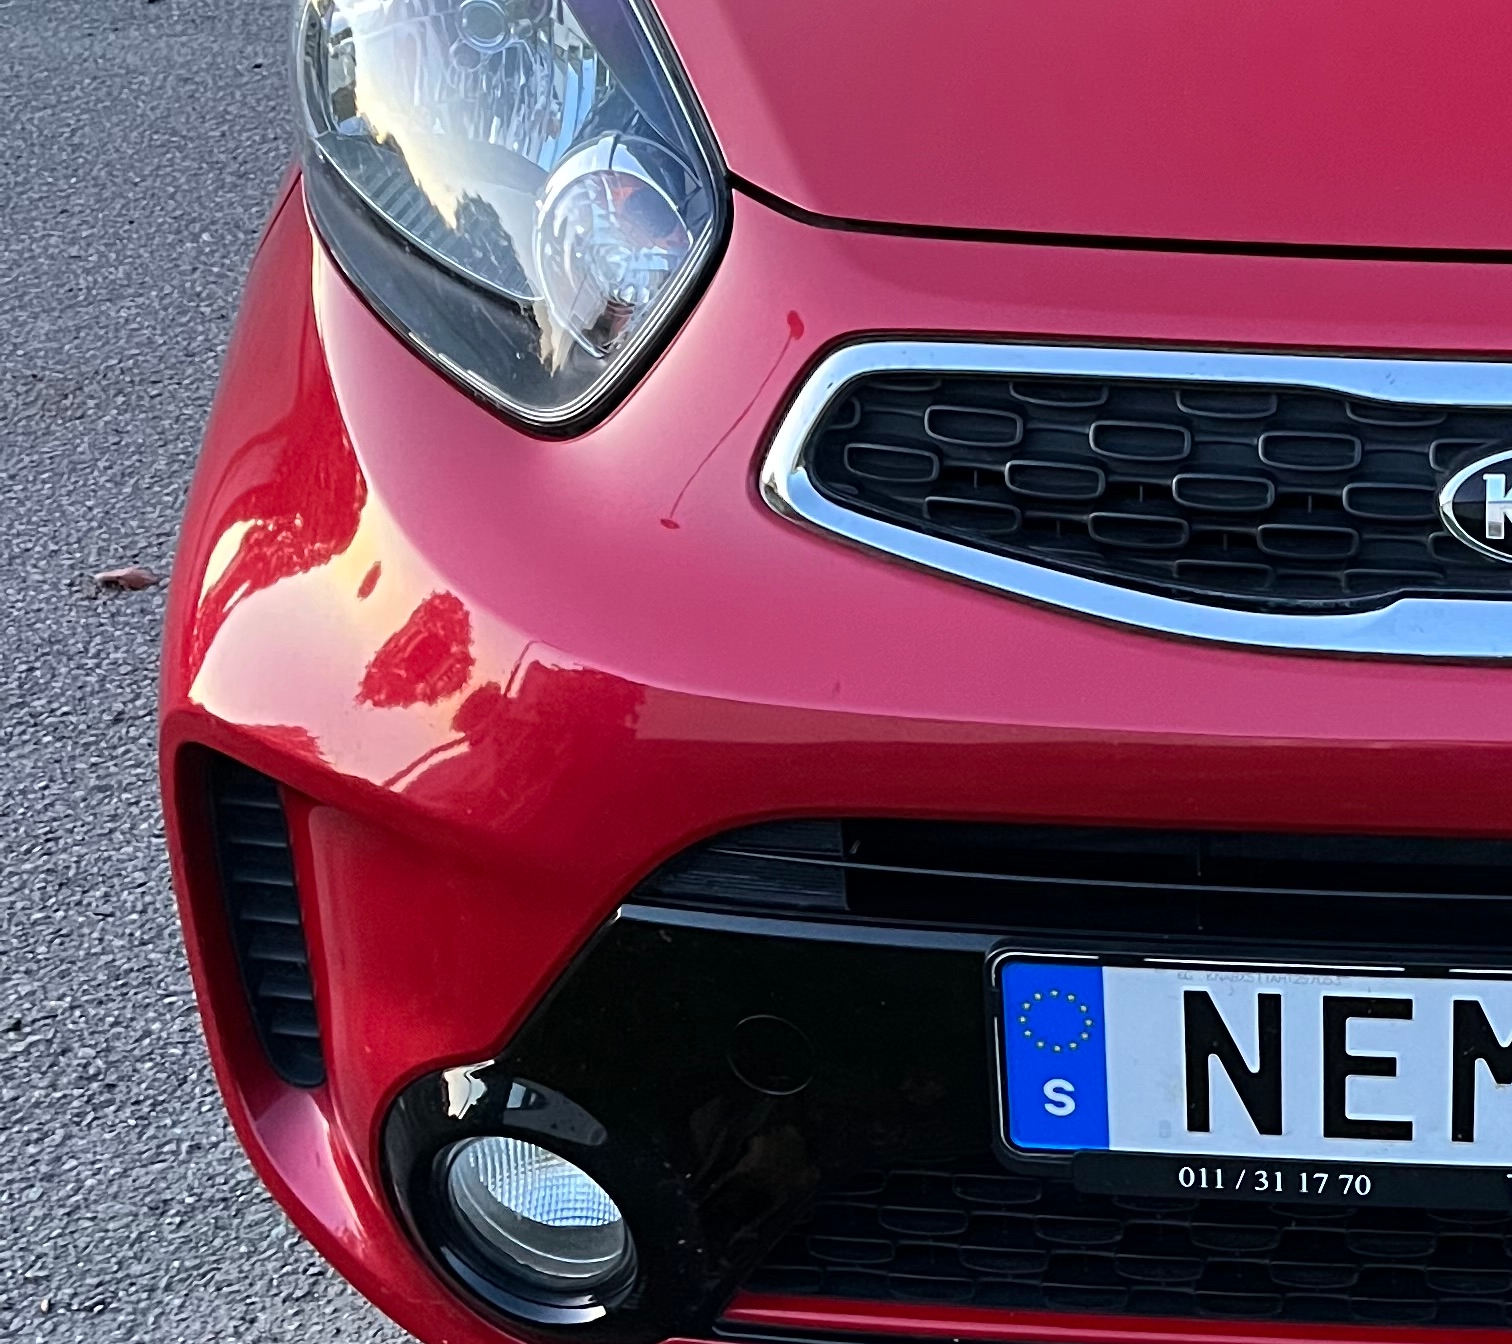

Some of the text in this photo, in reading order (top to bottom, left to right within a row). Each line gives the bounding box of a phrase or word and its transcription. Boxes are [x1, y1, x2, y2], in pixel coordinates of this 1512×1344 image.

[1043, 1078, 1076, 1117] S
[1178, 1166, 1225, 1189] 011
[1254, 1170, 1283, 1192] 31
[1299, 1172, 1329, 1194] 17
[1338, 1174, 1372, 1196] 70
